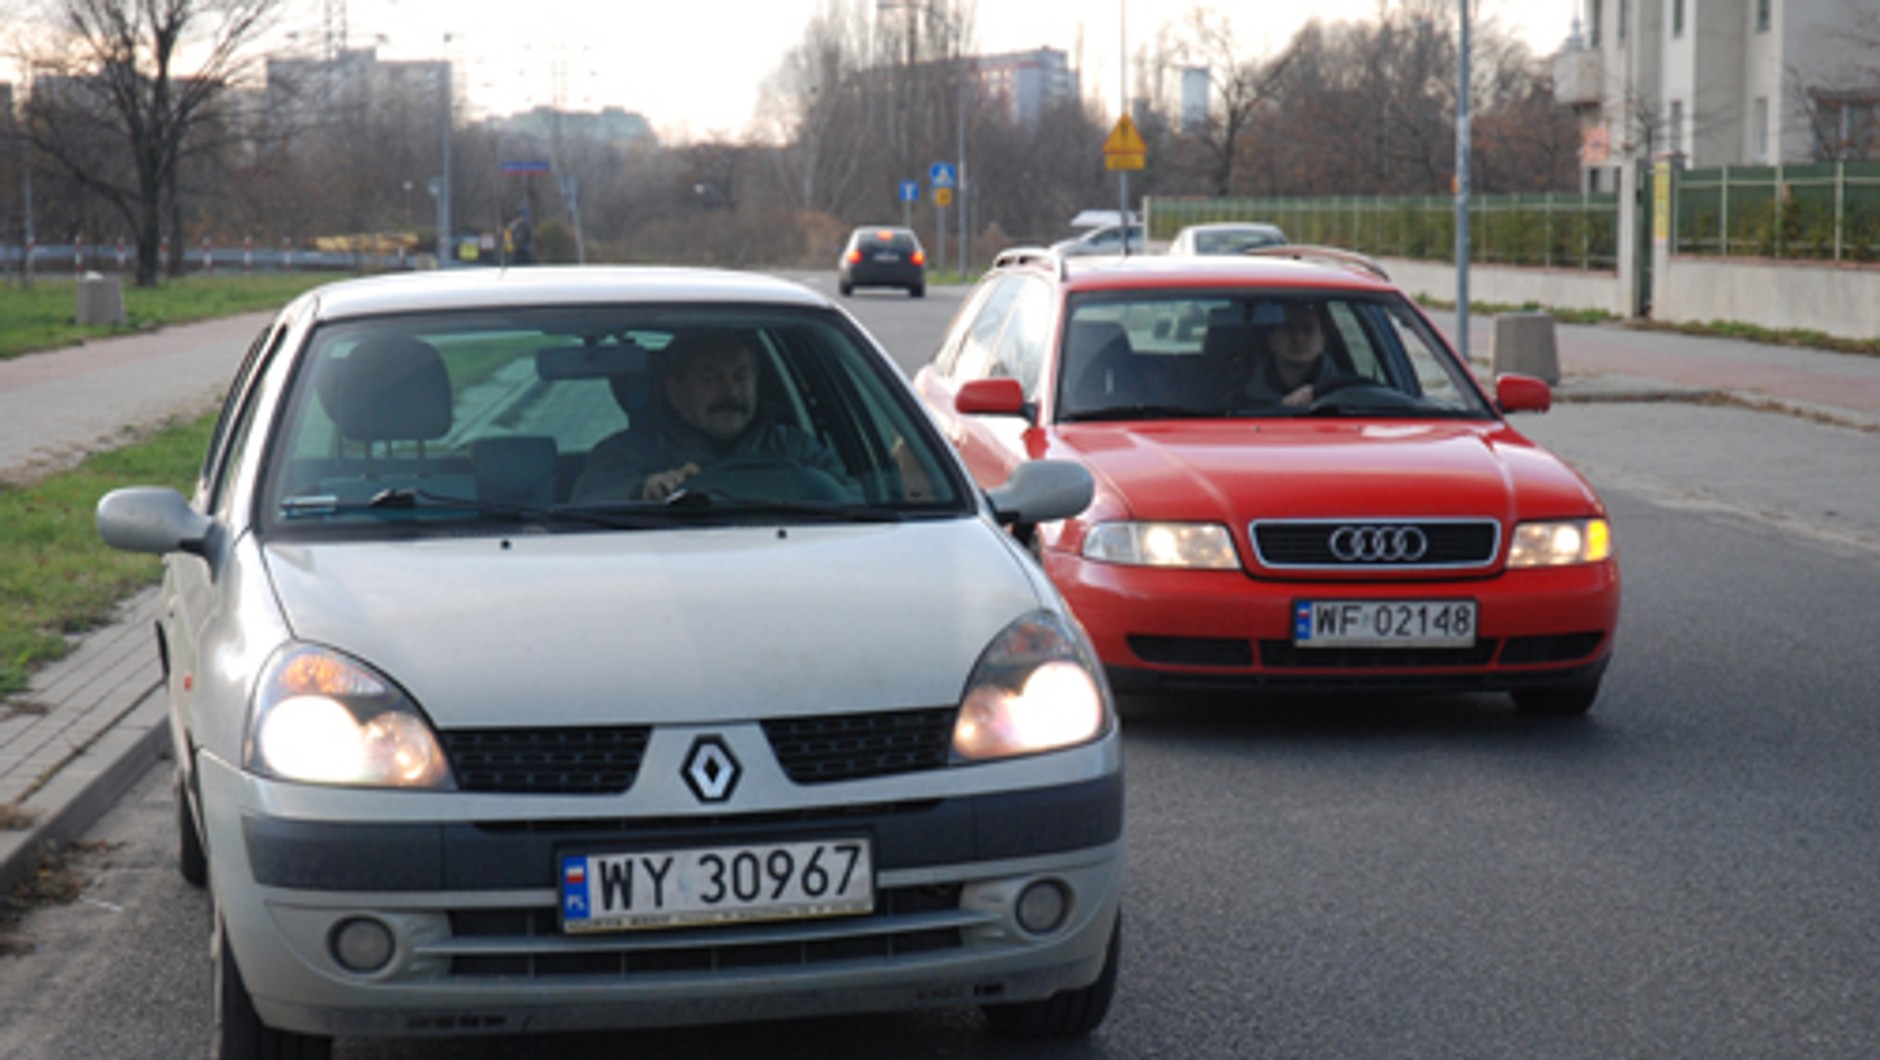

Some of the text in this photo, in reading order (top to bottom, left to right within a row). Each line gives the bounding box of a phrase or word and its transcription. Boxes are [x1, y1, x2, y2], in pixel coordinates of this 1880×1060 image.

[1316, 605, 1471, 636] WF 02148
[599, 845, 861, 910] WY 30967
